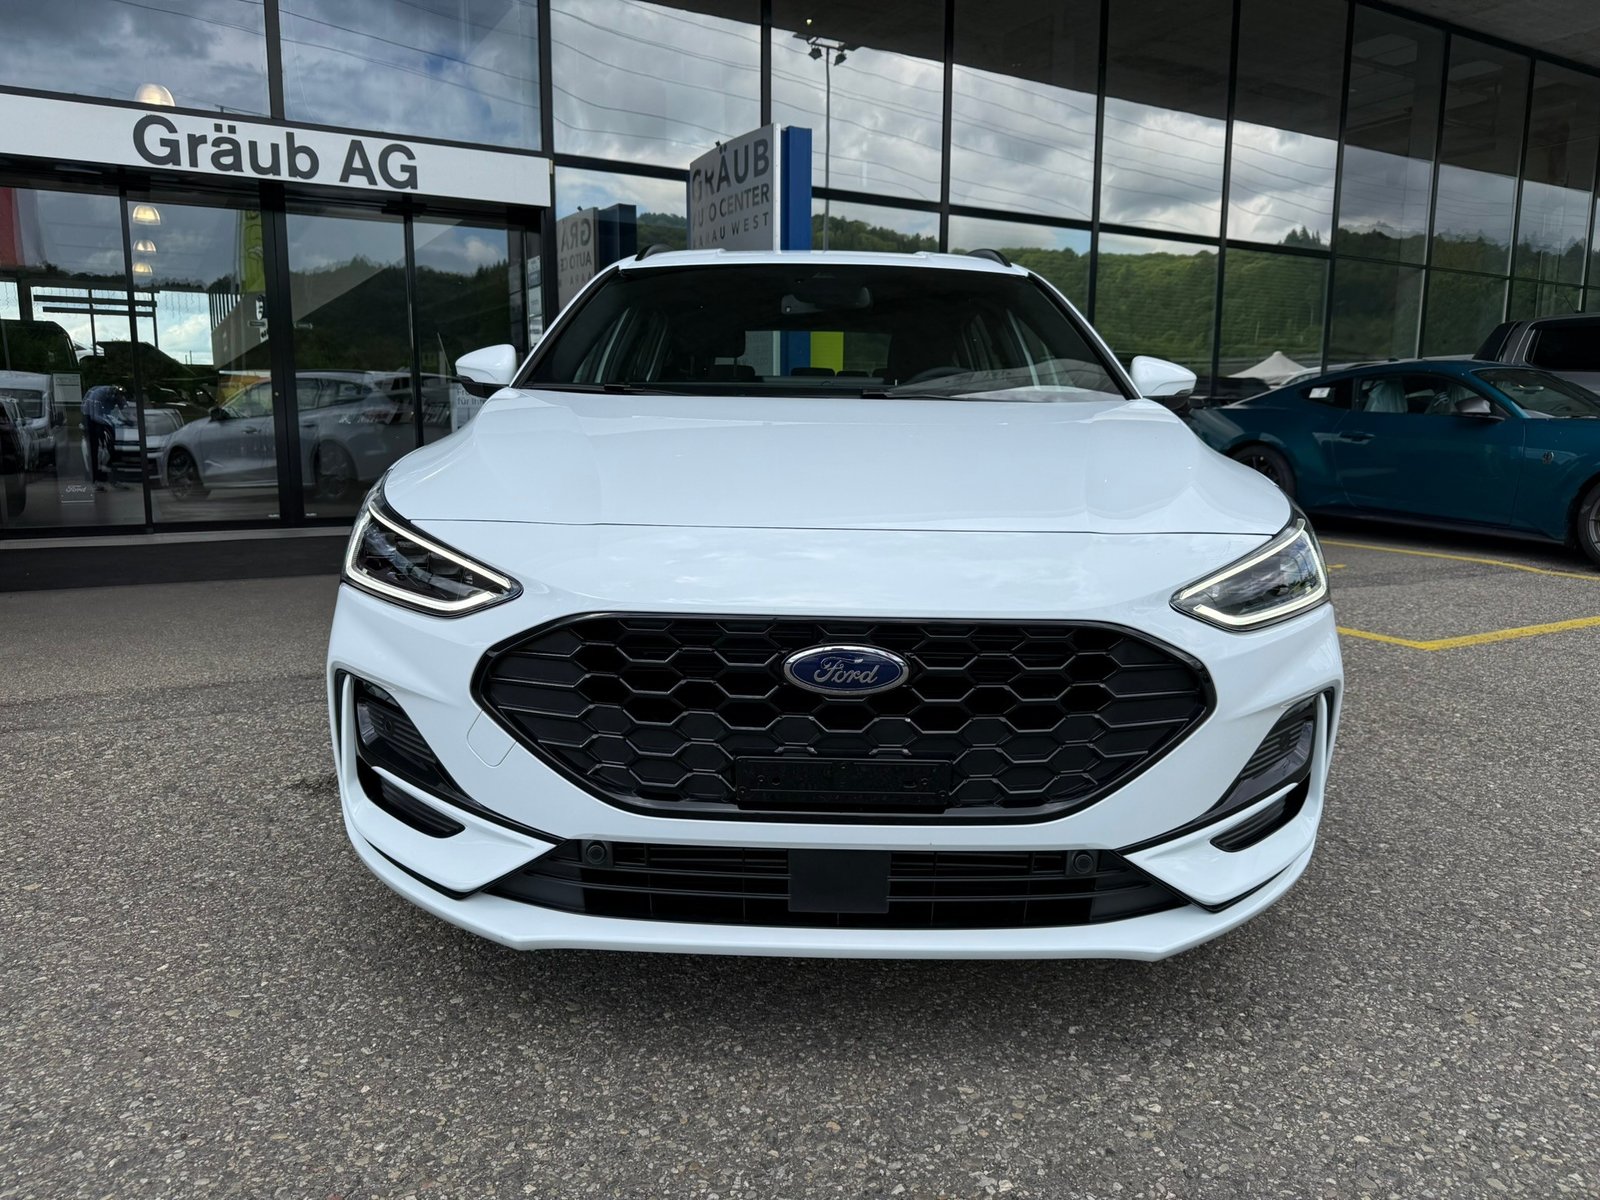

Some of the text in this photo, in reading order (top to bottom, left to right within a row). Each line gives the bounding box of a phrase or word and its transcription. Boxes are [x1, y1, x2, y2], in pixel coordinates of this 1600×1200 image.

[133, 114, 418, 190] Gräub AG
[692, 183, 770, 231] UOCENTER
[731, 212, 769, 236] WEST
[65, 485, 87, 493] Ford
[813, 656, 881, 684] Ford
